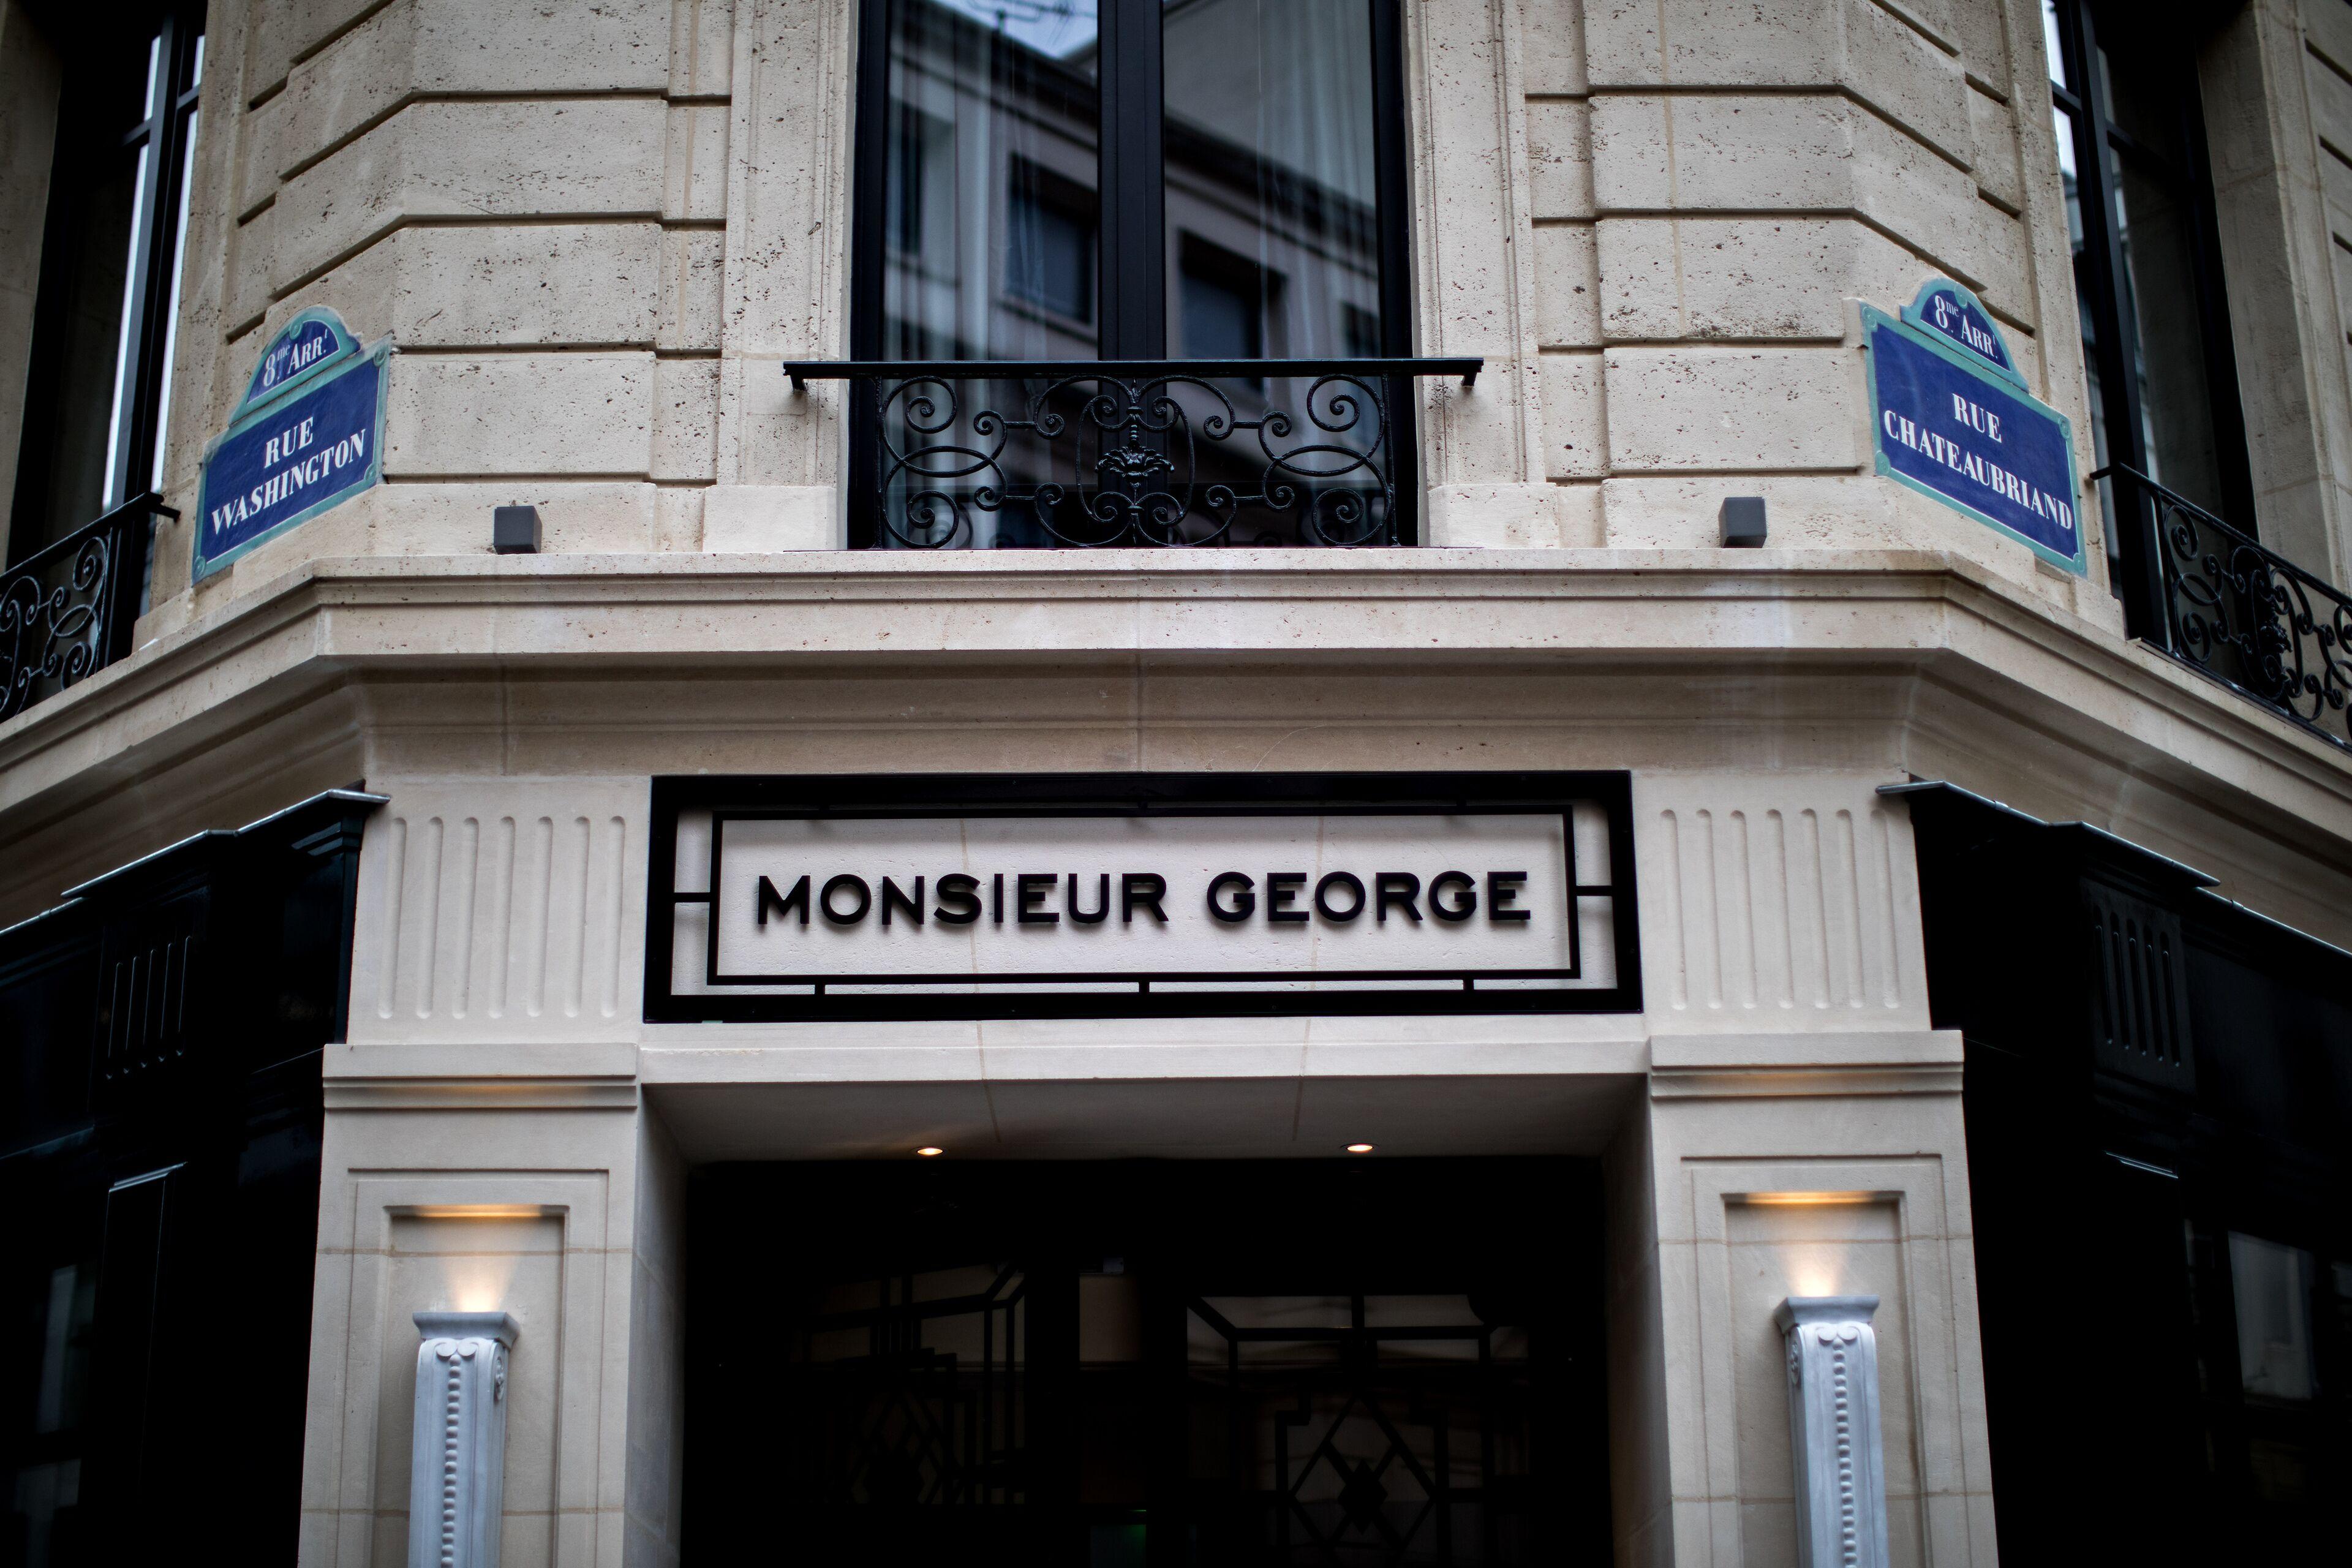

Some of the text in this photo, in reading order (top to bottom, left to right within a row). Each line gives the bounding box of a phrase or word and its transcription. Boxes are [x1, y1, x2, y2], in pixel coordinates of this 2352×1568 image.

[264, 417, 314, 469] RUE
[1952, 393, 2002, 443] RUE
[211, 429, 366, 535] WASHINGTON
[1883, 409, 2072, 530] CHATEAUBRIAND
[758, 870, 1532, 925] MONSIEUR GEORGE
